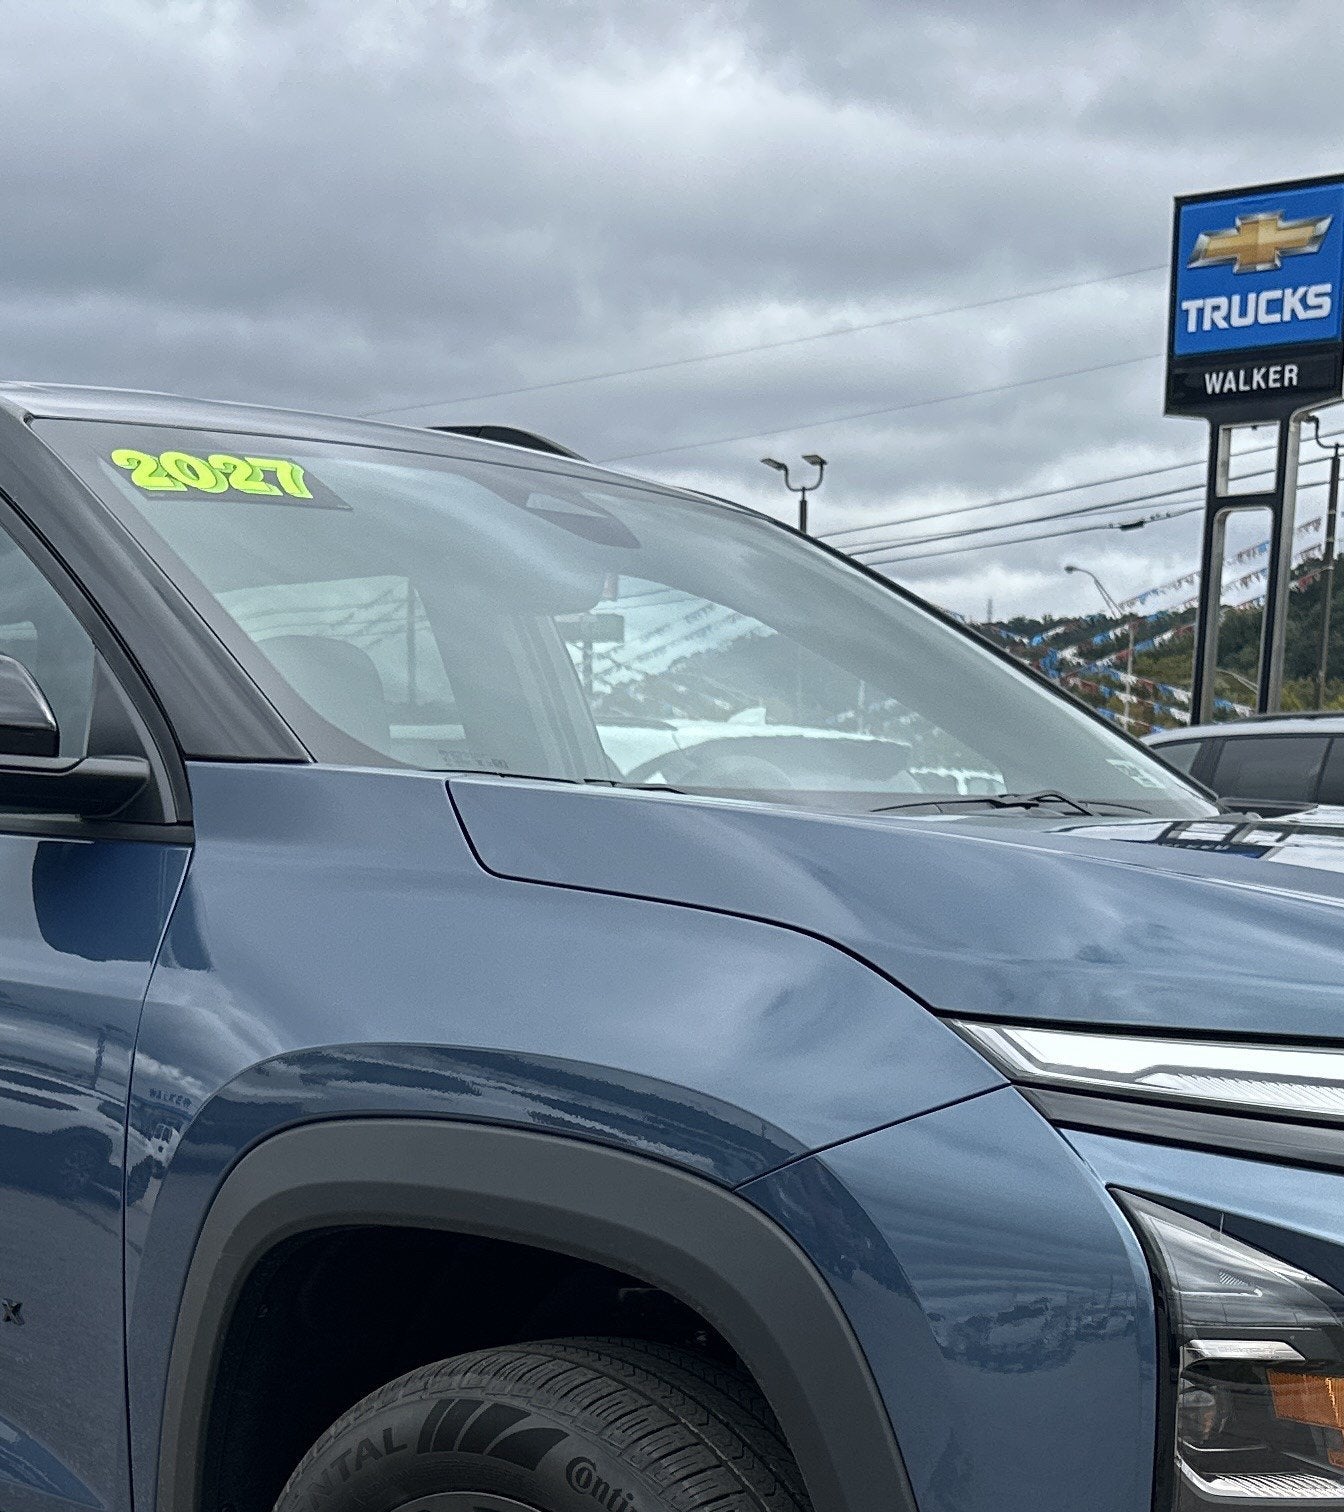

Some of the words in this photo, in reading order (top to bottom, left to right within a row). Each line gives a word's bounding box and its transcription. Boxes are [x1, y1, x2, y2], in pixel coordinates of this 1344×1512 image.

[1181, 283, 1333, 334] TRUCKS
[1204, 363, 1299, 395] WALKER
[111, 449, 313, 499] 2027
